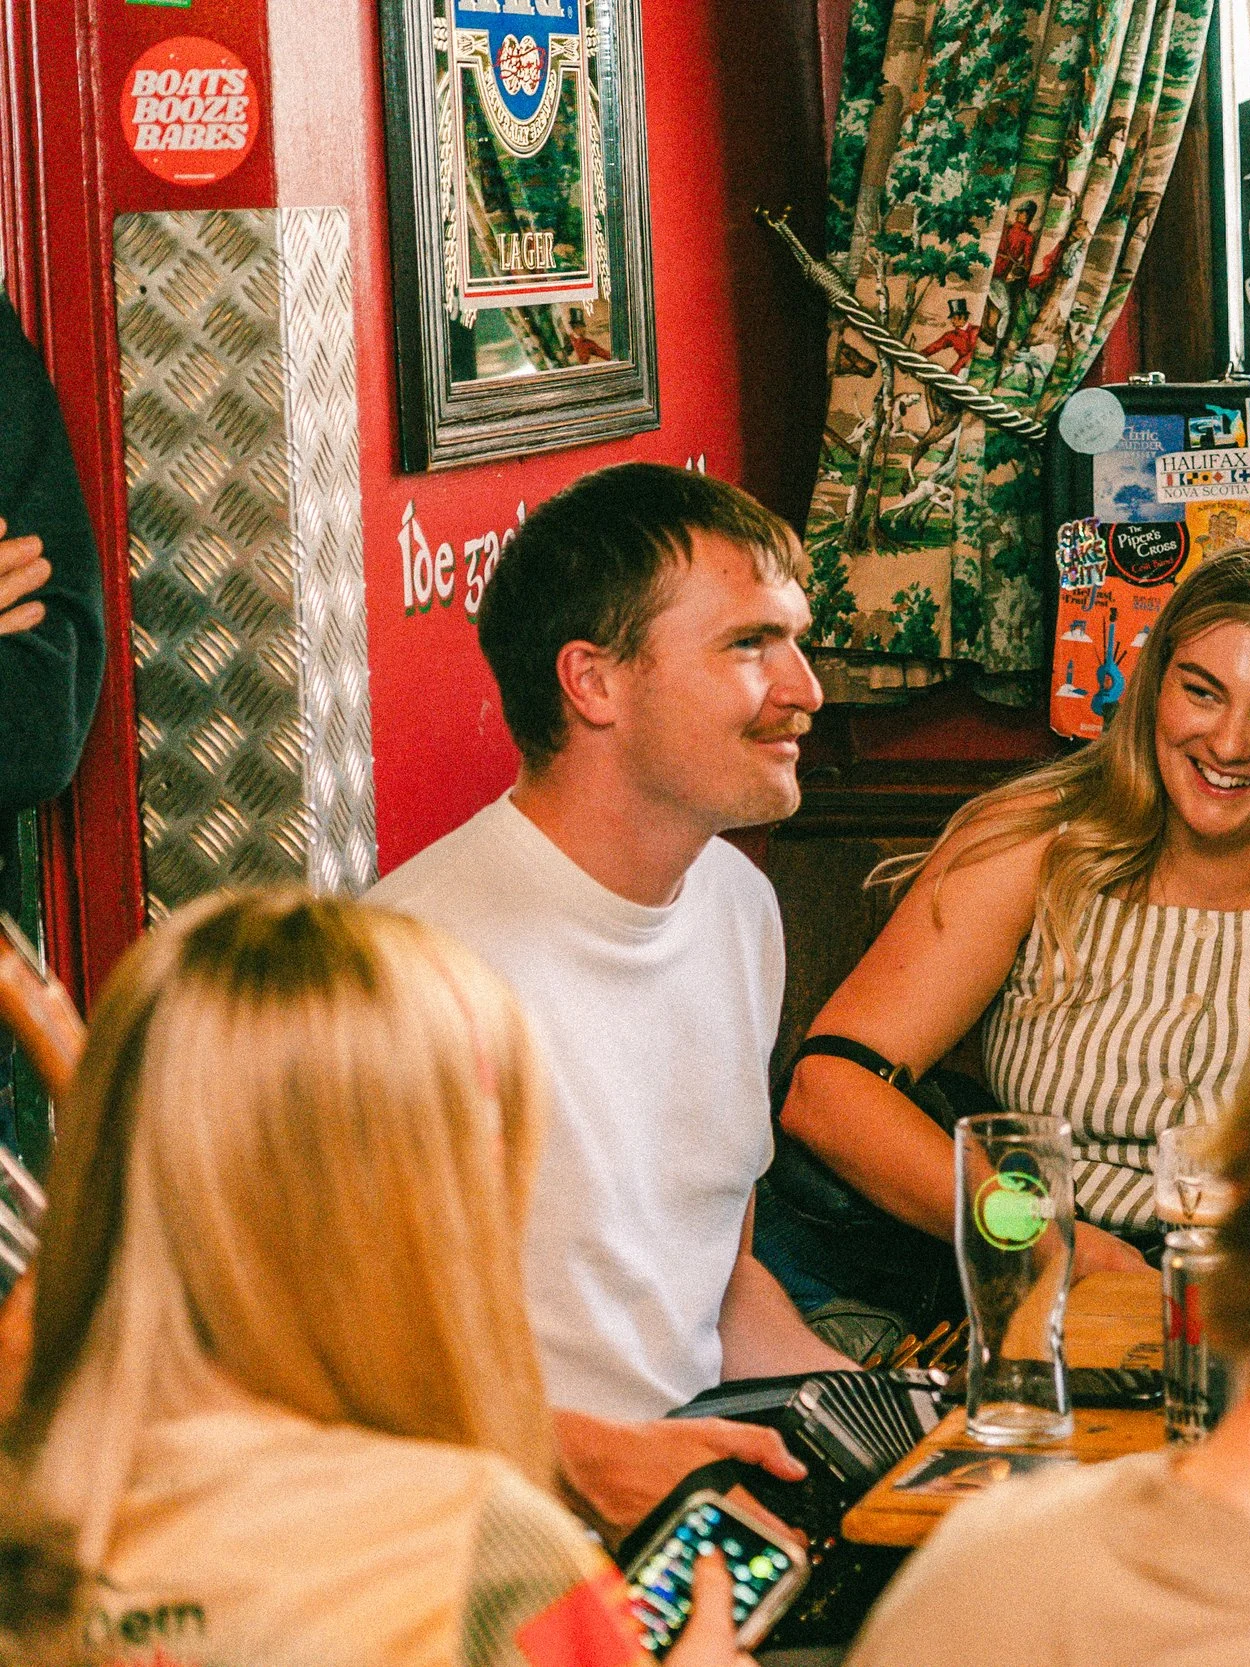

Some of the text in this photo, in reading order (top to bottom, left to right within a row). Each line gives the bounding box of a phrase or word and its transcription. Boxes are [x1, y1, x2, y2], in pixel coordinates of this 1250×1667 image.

[131, 68, 249, 97] BOATS
[131, 95, 250, 124] BOOZE
[133, 123, 249, 151] BABES
[500, 231, 557, 271] LAGER
[1162, 451, 1248, 472] HALIFAX
[1164, 484, 1250, 499] NOVA SCOTIA
[1128, 525, 1143, 534] The
